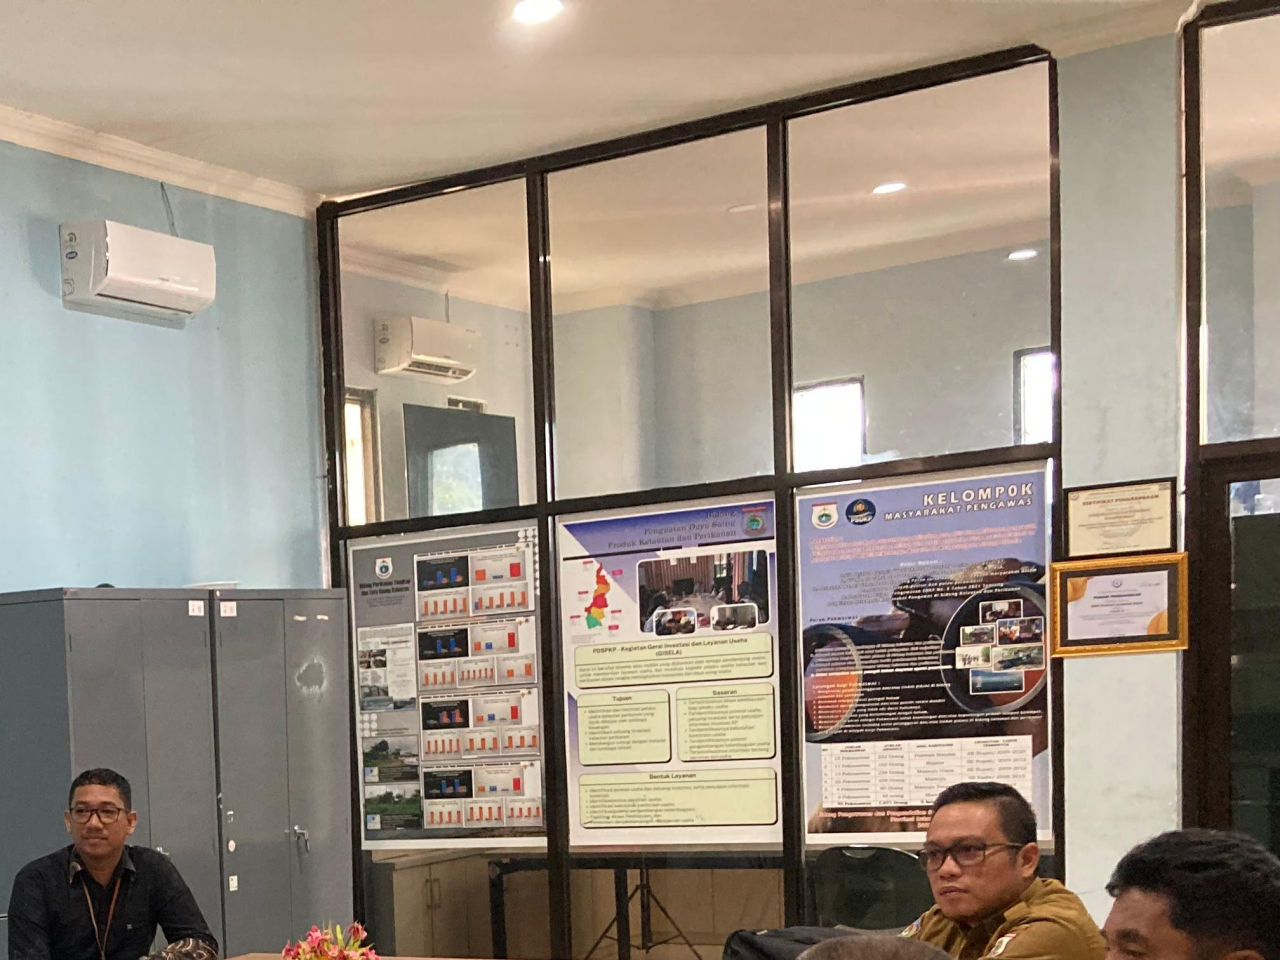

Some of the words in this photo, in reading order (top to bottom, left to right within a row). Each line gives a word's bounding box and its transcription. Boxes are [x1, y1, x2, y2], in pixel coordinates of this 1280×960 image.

[923, 482, 1033, 506] KELOMPOK
[884, 505, 962, 520] MASYARAKAT
[966, 498, 1032, 512] PENGAWAS
[644, 524, 687, 535] Penguatan
[689, 522, 710, 532] Daya
[712, 520, 736, 530] Saing
[608, 539, 637, 549] Produk
[639, 535, 674, 546] Kelautan
[677, 533, 692, 542] dan
[694, 530, 736, 540] Perikanan
[656, 649, 682, 657] (GISELA)
